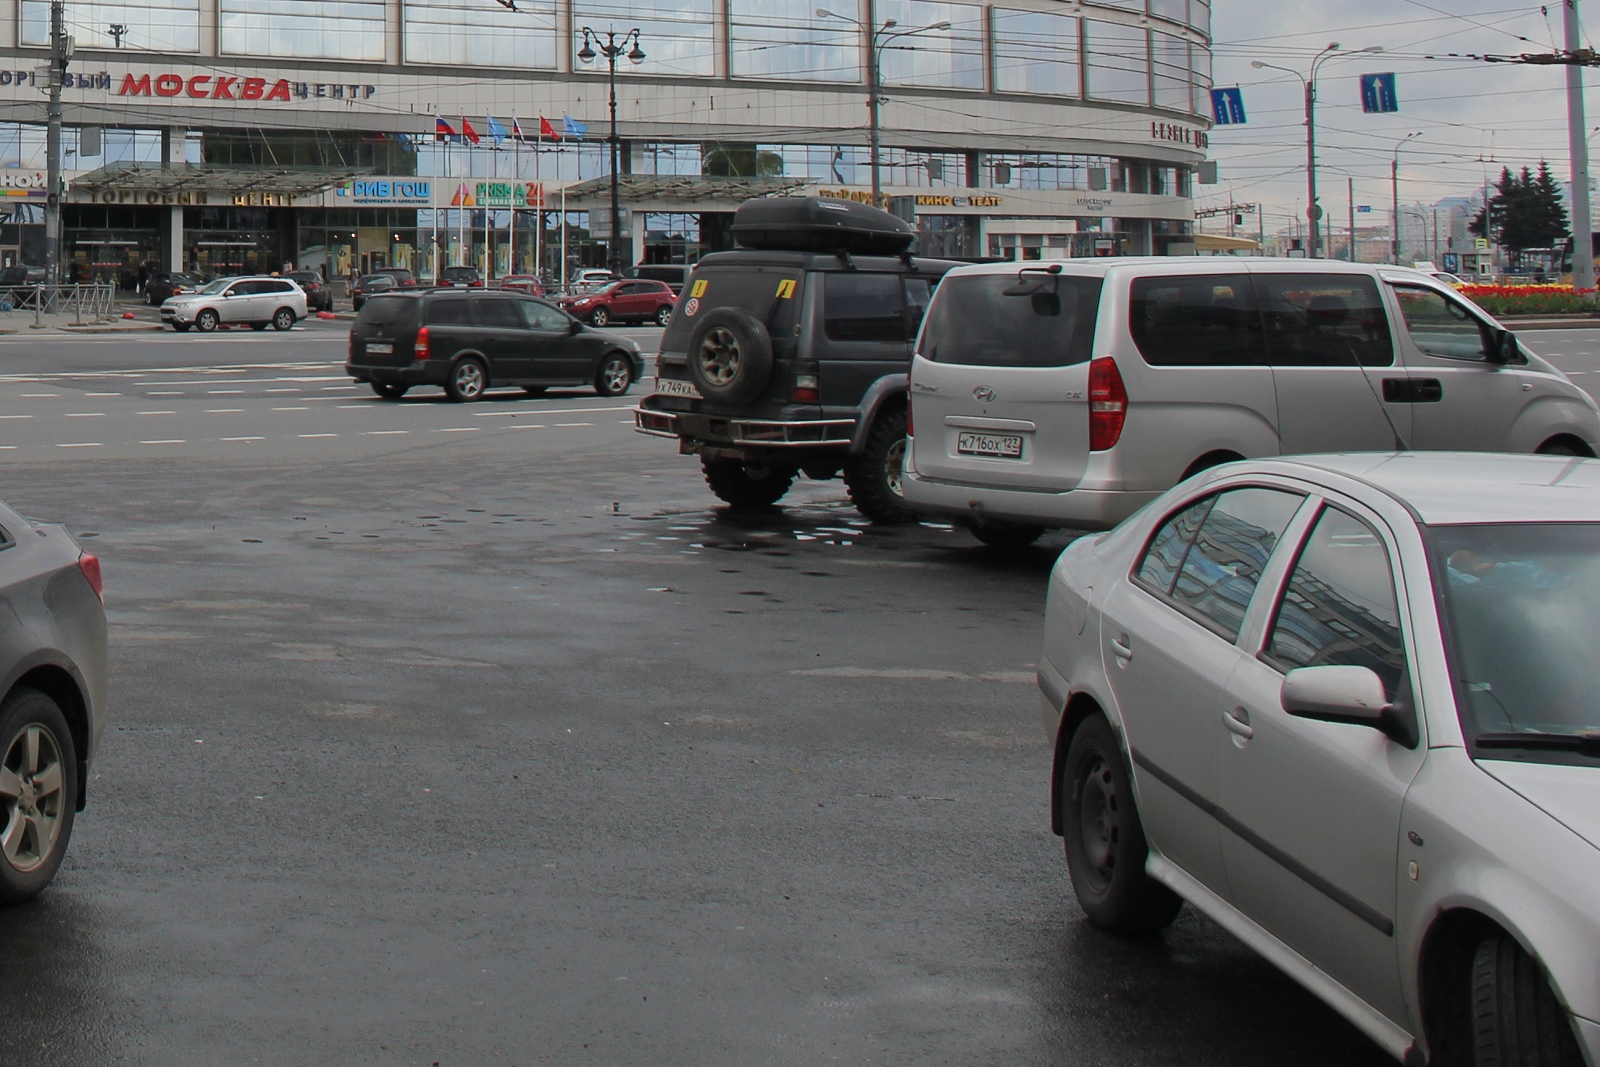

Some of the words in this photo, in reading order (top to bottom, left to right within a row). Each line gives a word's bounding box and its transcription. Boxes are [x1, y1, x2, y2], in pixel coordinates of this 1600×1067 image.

[119, 73, 291, 101] МОСКВА
[293, 81, 375, 99] ЦЕНТР
[354, 181, 390, 197] РИВ
[393, 182, 430, 198] ГОШ
[476, 182, 526, 198] PRISMA
[526, 182, 544, 198] 24
[917, 195, 949, 207] КИНО
[968, 196, 1003, 207] ТЕАТР
[1002, 437, 1018, 449] 123
